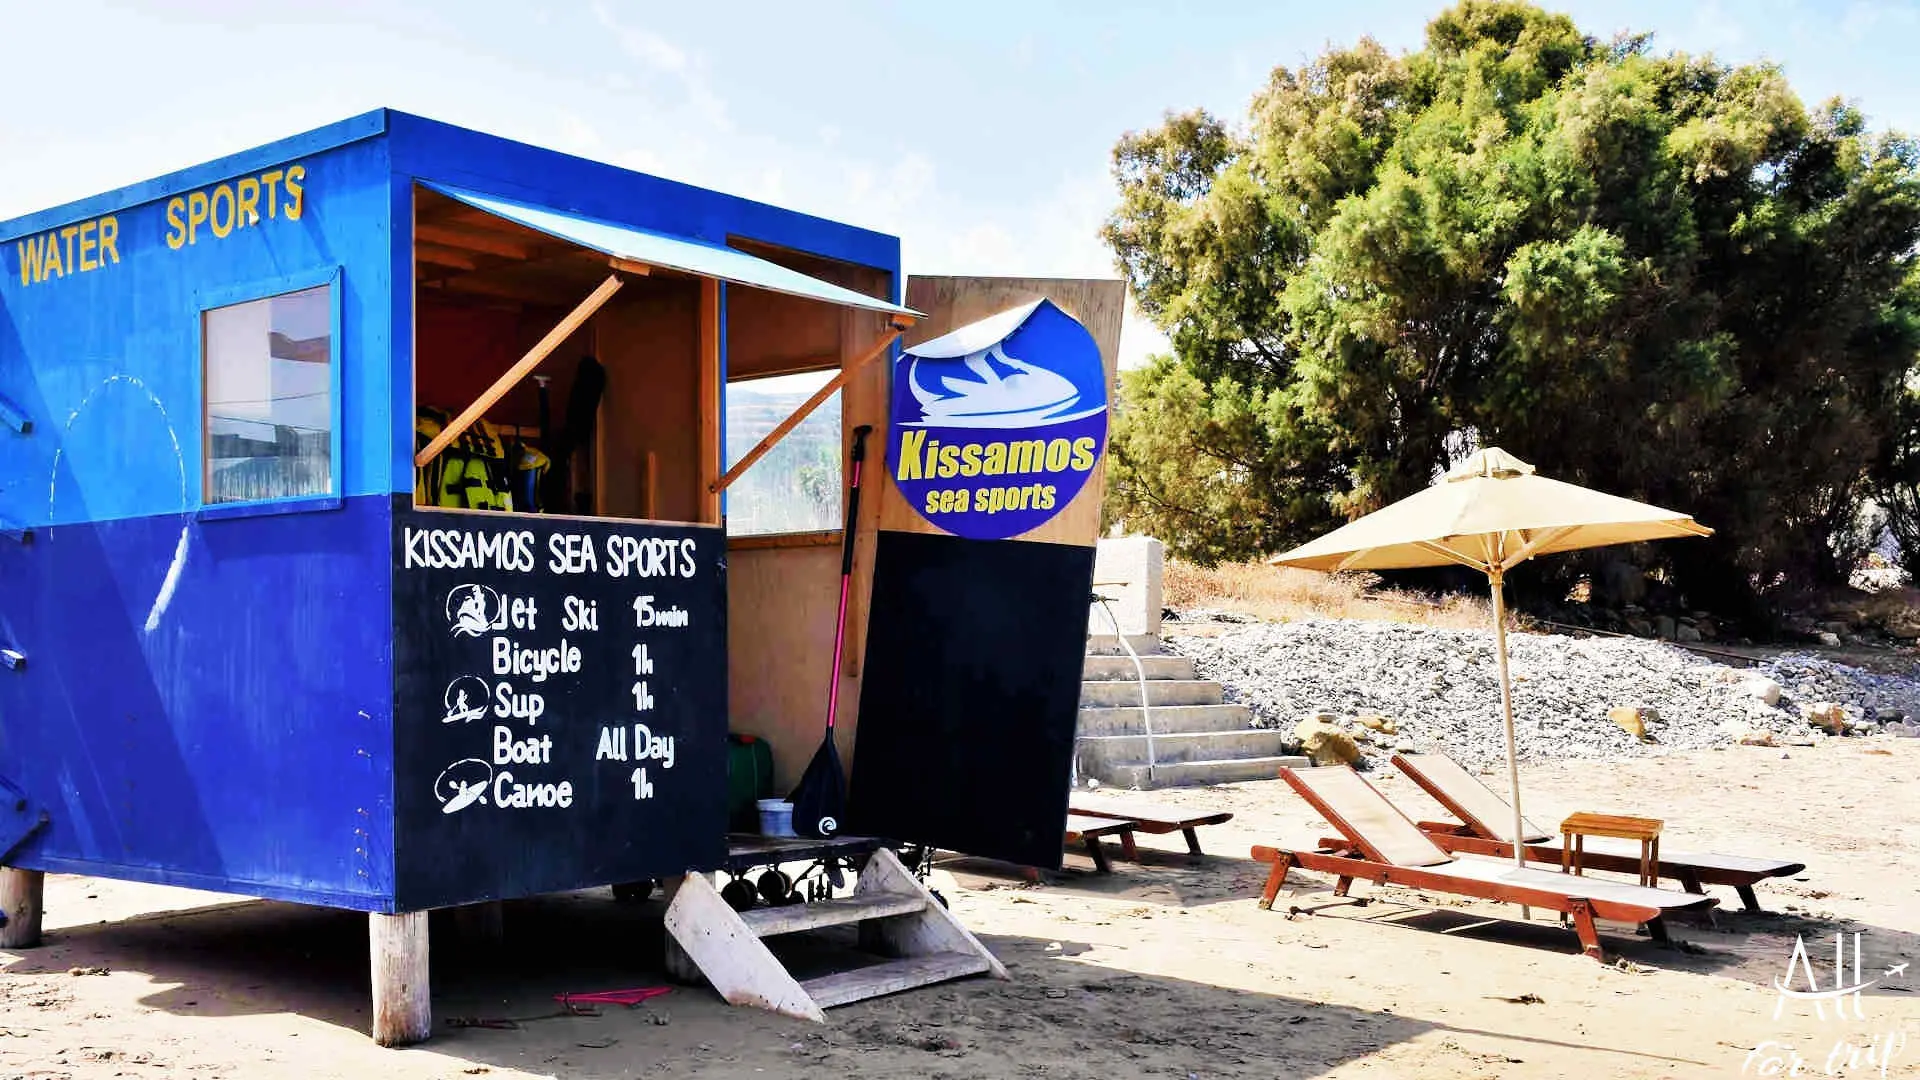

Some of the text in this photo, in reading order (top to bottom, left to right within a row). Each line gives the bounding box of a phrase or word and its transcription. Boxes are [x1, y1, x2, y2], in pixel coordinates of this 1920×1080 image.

[18, 166, 306, 287] WATER SPORTS
[897, 430, 1096, 481] Kissamos
[925, 484, 1057, 514] sea sports
[404, 527, 696, 577] KISSAMOS SEA SPORTS
[492, 594, 537, 631] Jet
[562, 595, 599, 631] Ski
[492, 637, 654, 682] Bicycle 1h
[494, 681, 654, 725] Sup 1h
[494, 724, 675, 768] Boat All Day
[494, 768, 654, 808] Canoe 1h
